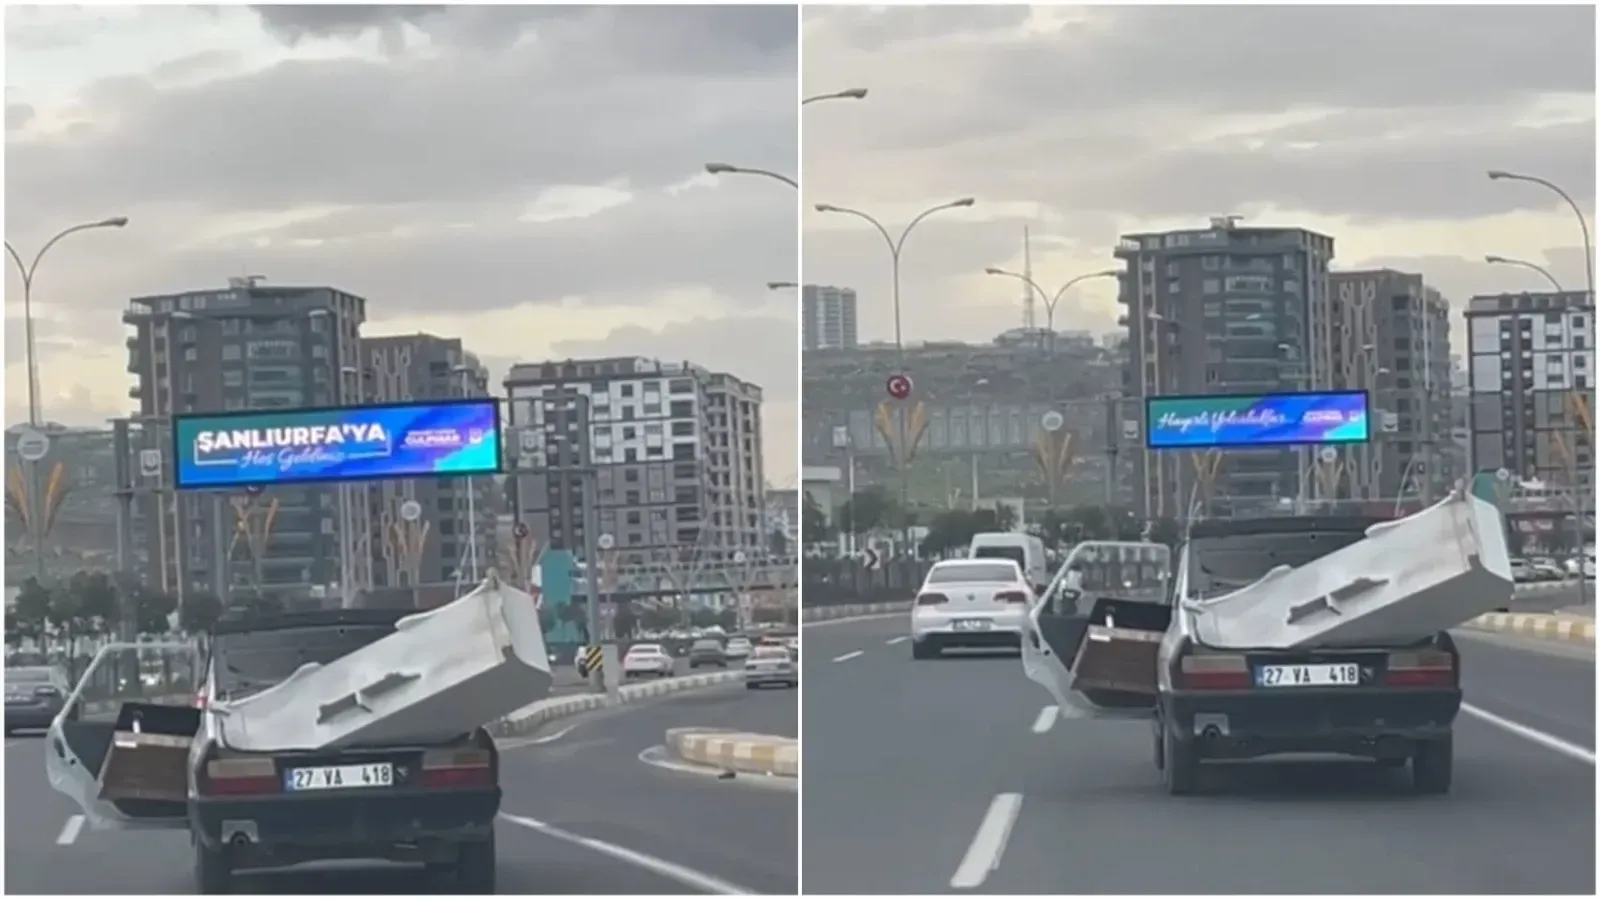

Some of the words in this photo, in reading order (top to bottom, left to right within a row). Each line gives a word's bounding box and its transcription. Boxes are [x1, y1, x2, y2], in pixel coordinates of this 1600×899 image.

[197, 423, 387, 453] ŞANLIURFA'YA
[1266, 667, 1283, 684] 27
[1293, 667, 1311, 683] VA
[1329, 665, 1356, 682] 418
[296, 770, 314, 788] 27
[323, 768, 342, 785] VA
[362, 766, 389, 784] 418
